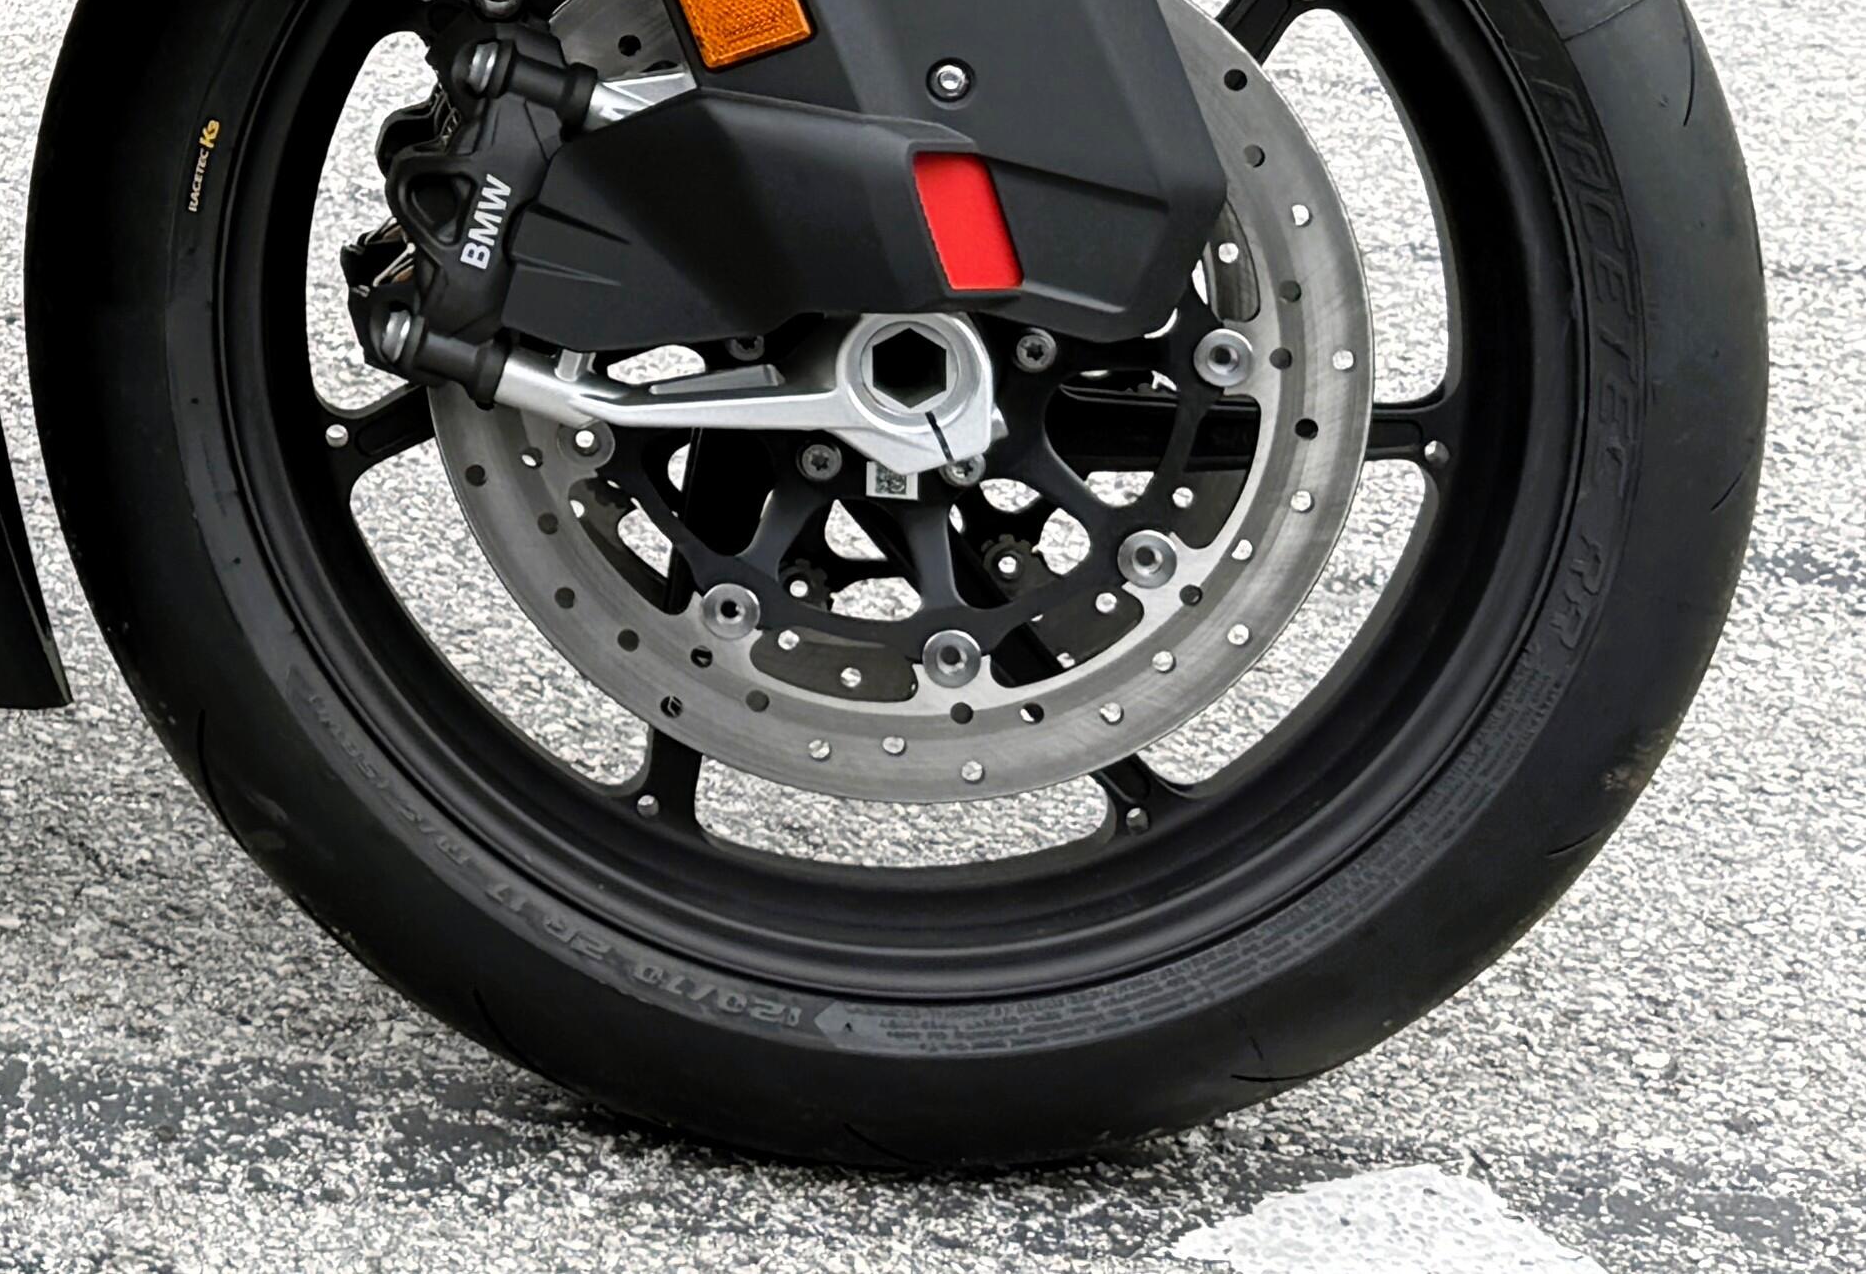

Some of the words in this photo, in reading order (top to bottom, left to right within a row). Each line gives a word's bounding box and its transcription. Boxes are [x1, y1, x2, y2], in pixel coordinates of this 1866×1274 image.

[187, 150, 210, 213] RACETEC
[459, 173, 513, 271] BMW
[1529, 73, 1635, 501] RACETEC
